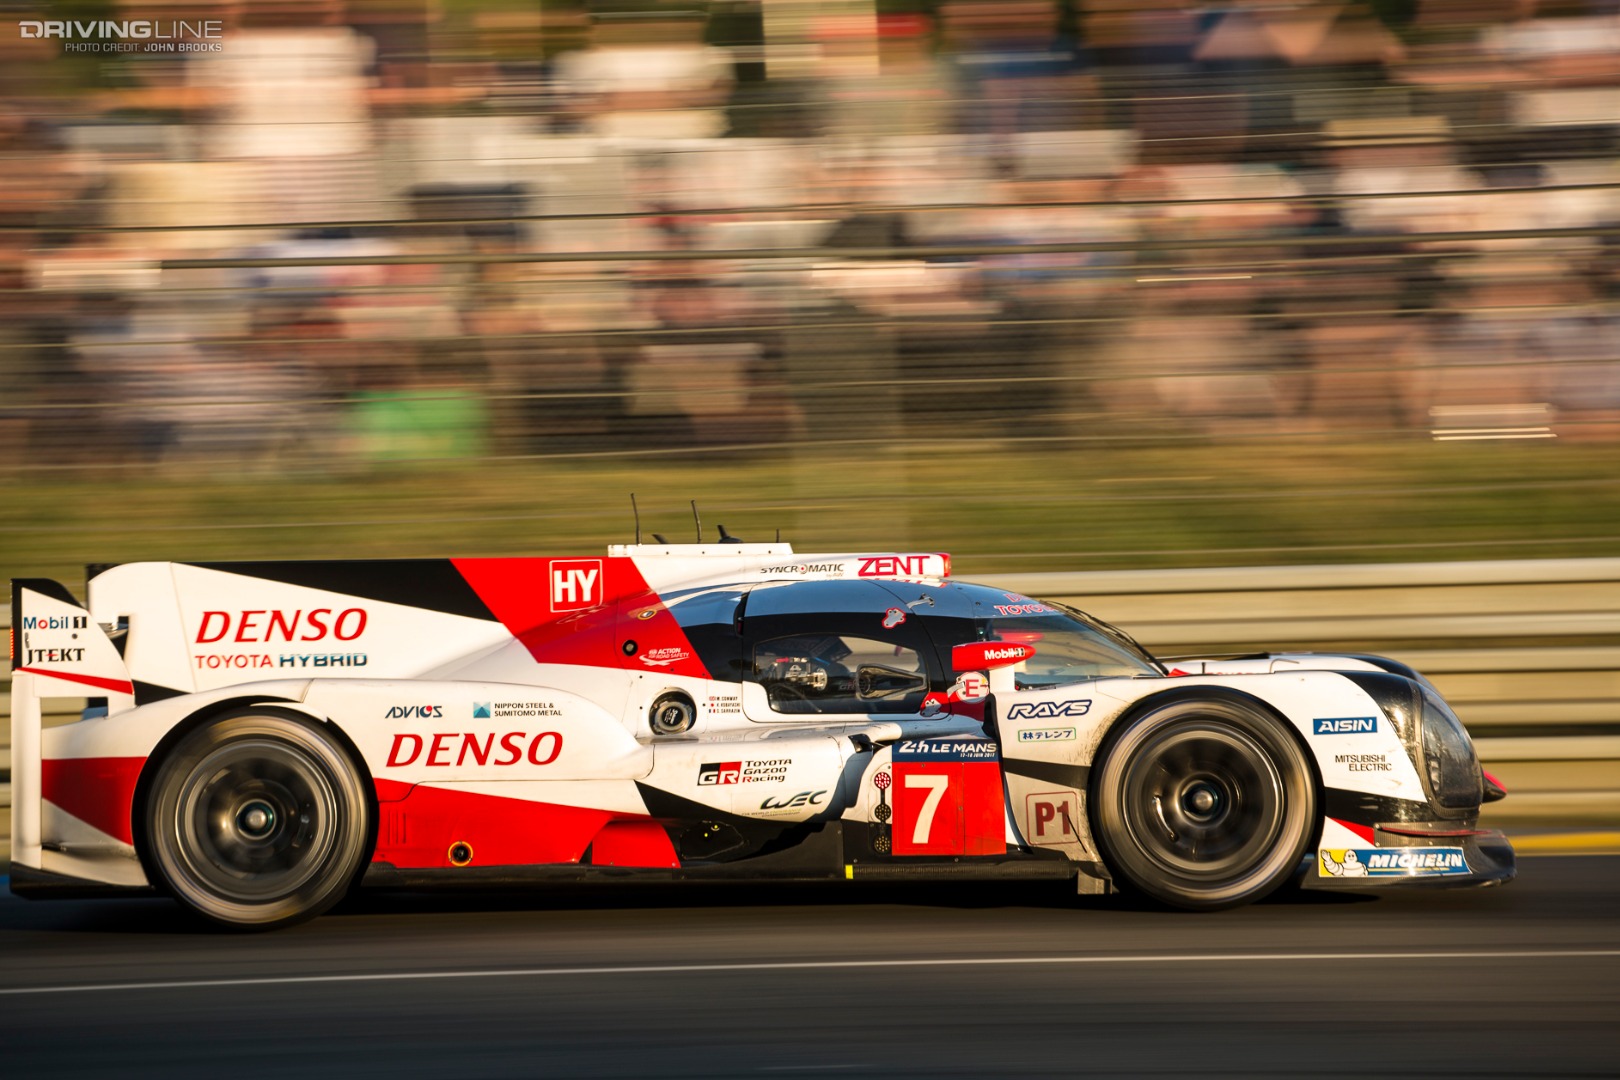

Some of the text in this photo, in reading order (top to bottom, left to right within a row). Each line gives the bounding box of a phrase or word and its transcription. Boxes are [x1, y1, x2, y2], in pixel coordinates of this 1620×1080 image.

[858, 556, 930, 577] ZENT
[553, 569, 599, 603] HY
[23, 616, 88, 630] Mobil 1
[195, 608, 368, 643] DENSO
[26, 648, 85, 666] JTEKT
[195, 653, 368, 669] TOYOTA HYBRID
[984, 648, 1014, 660] Mobil
[965, 679, 980, 697] E
[385, 705, 443, 719] ADVICS
[494, 709, 537, 717] SUMITOMO
[1007, 699, 1092, 720] RAYS
[1318, 719, 1373, 733] AISIN
[386, 731, 563, 767] DENSO
[931, 743, 951, 753] LE
[952, 743, 997, 753] MANS
[744, 759, 792, 767] TOYOTA
[1335, 754, 1386, 763] MITSUBISHI
[743, 767, 787, 775] GAZOO
[1348, 763, 1392, 771] ELECTRIC
[699, 770, 739, 785] GR
[742, 775, 786, 783] Racing
[760, 790, 827, 810] WEC
[904, 774, 949, 844] 7
[1034, 800, 1071, 836] P1
[1368, 854, 1463, 868] MICHELIN
